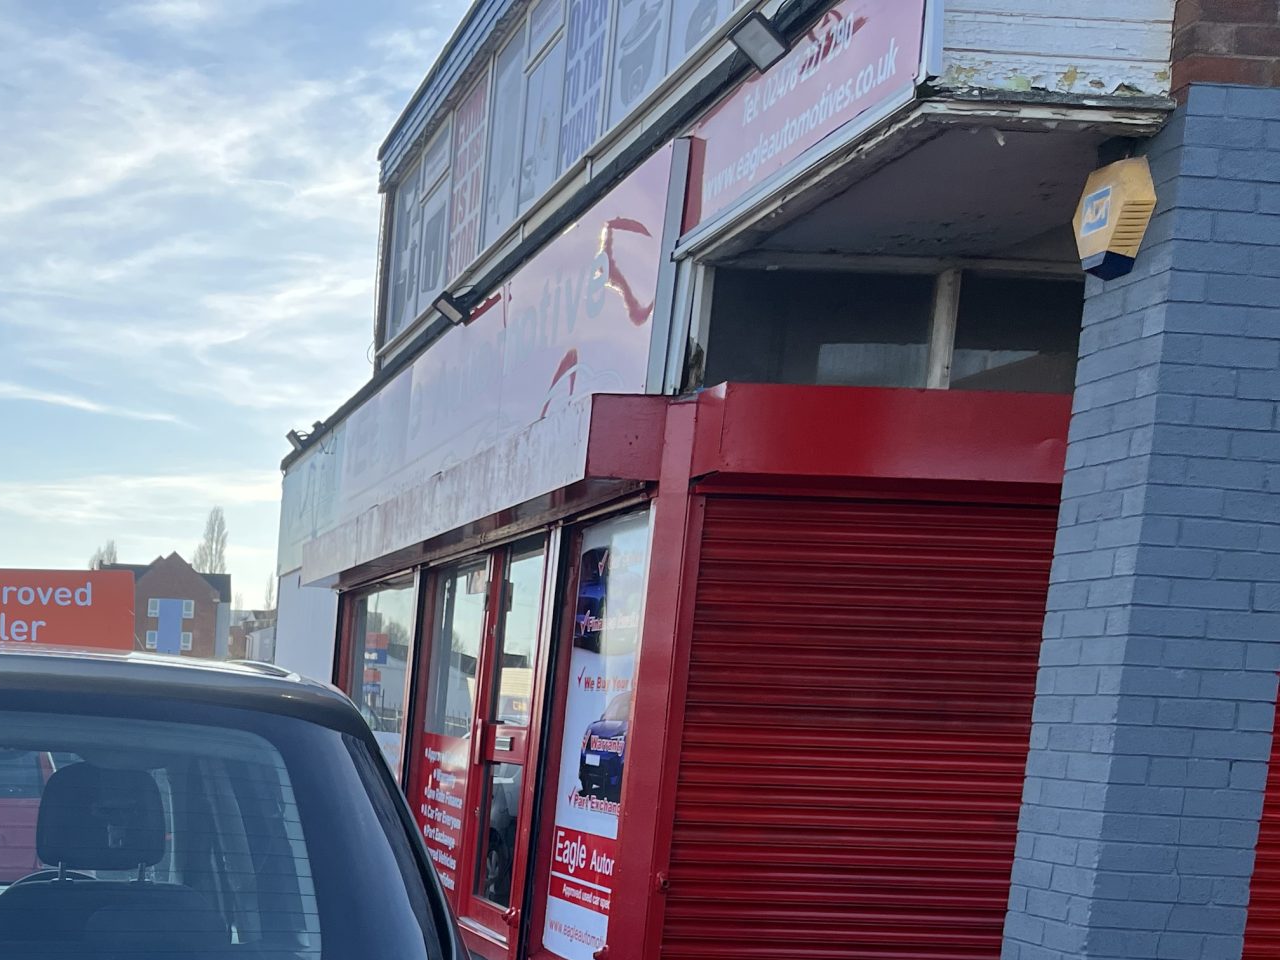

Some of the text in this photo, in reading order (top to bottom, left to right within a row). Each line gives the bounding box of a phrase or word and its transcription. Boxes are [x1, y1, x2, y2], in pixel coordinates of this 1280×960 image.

[705, 37, 900, 197] www.eagleautomotives.co.uk
[591, 735, 625, 756] Warranty
[574, 793, 589, 808] Part
[555, 831, 586, 874] Eagle
